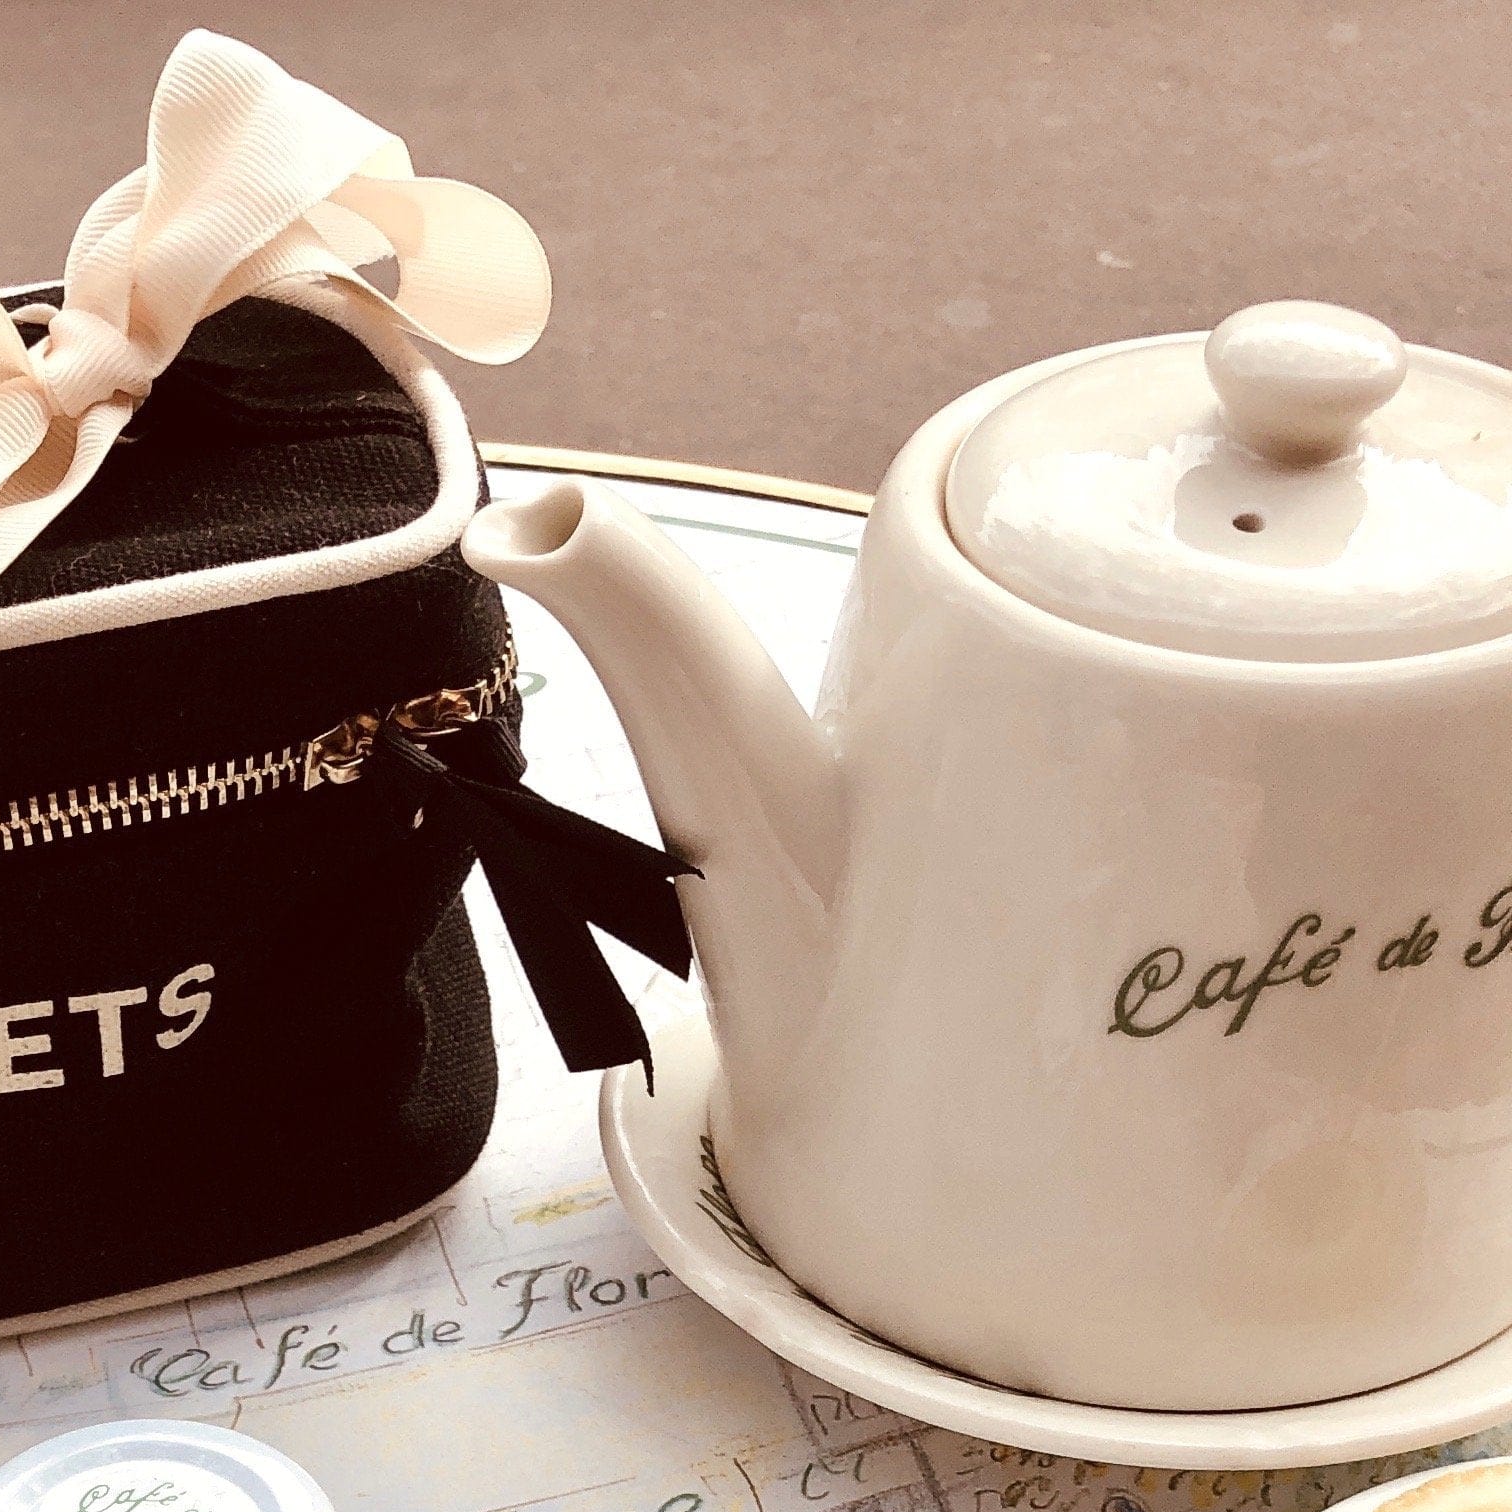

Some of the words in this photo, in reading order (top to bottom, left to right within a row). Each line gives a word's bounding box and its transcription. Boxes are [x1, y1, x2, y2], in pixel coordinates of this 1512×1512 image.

[1108, 914, 1356, 1037] Café
[1378, 914, 1439, 971] de
[130, 1324, 340, 1398] Café
[382, 1308, 465, 1352] de
